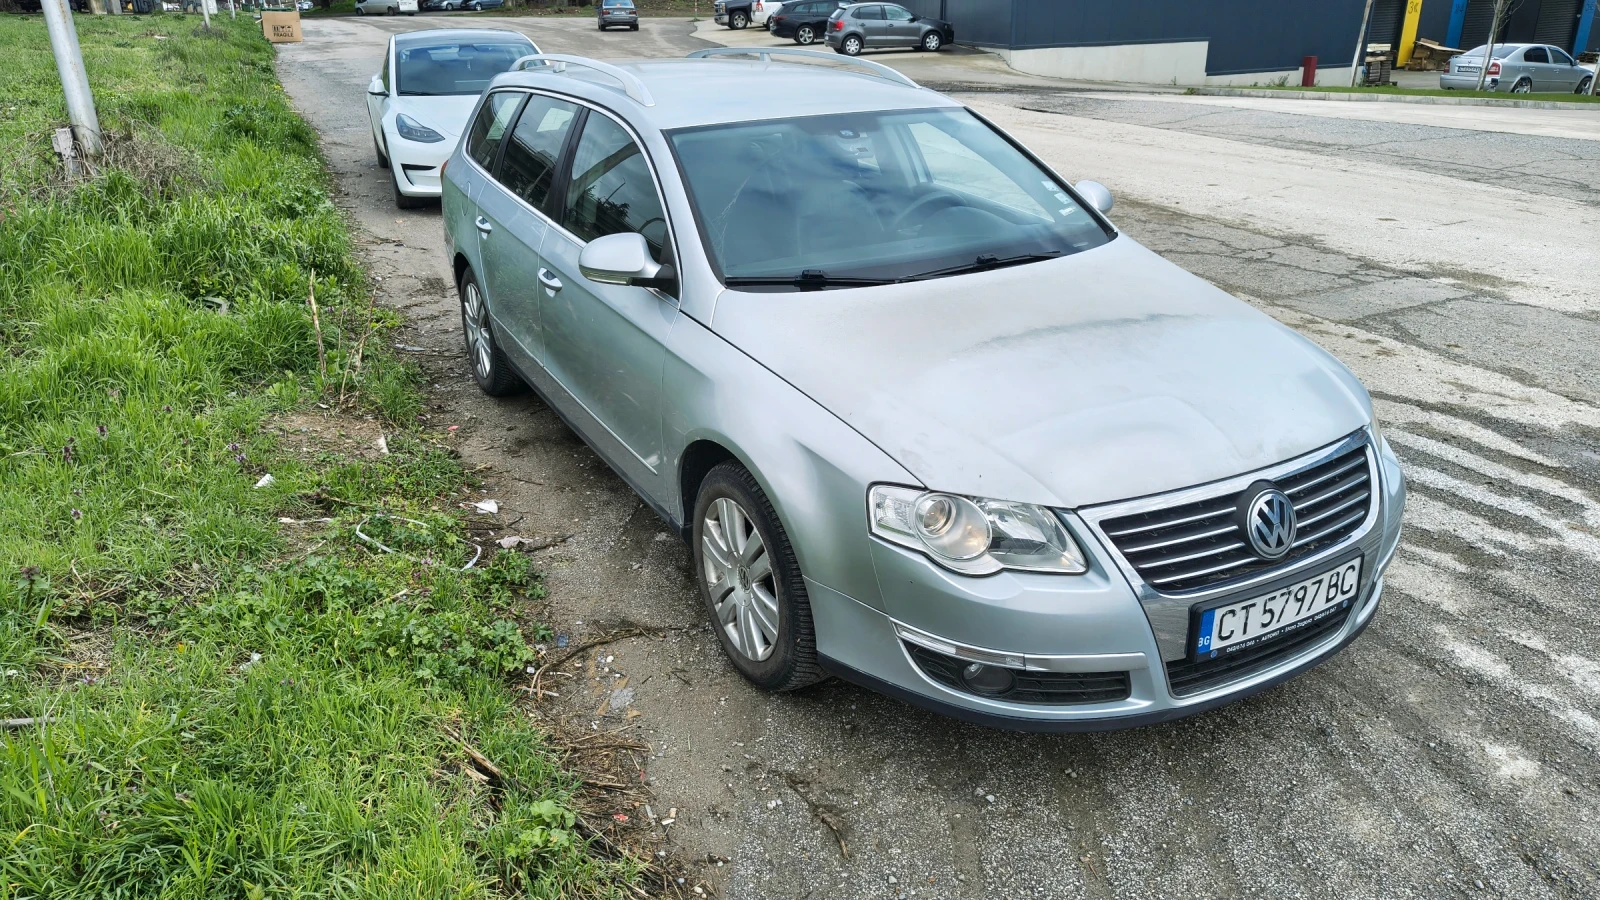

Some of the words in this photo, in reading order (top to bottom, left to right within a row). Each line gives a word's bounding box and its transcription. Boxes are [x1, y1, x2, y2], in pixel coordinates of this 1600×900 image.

[1218, 602, 1257, 641] CT
[1260, 578, 1324, 628] 5797
[1325, 564, 1355, 604] BC
